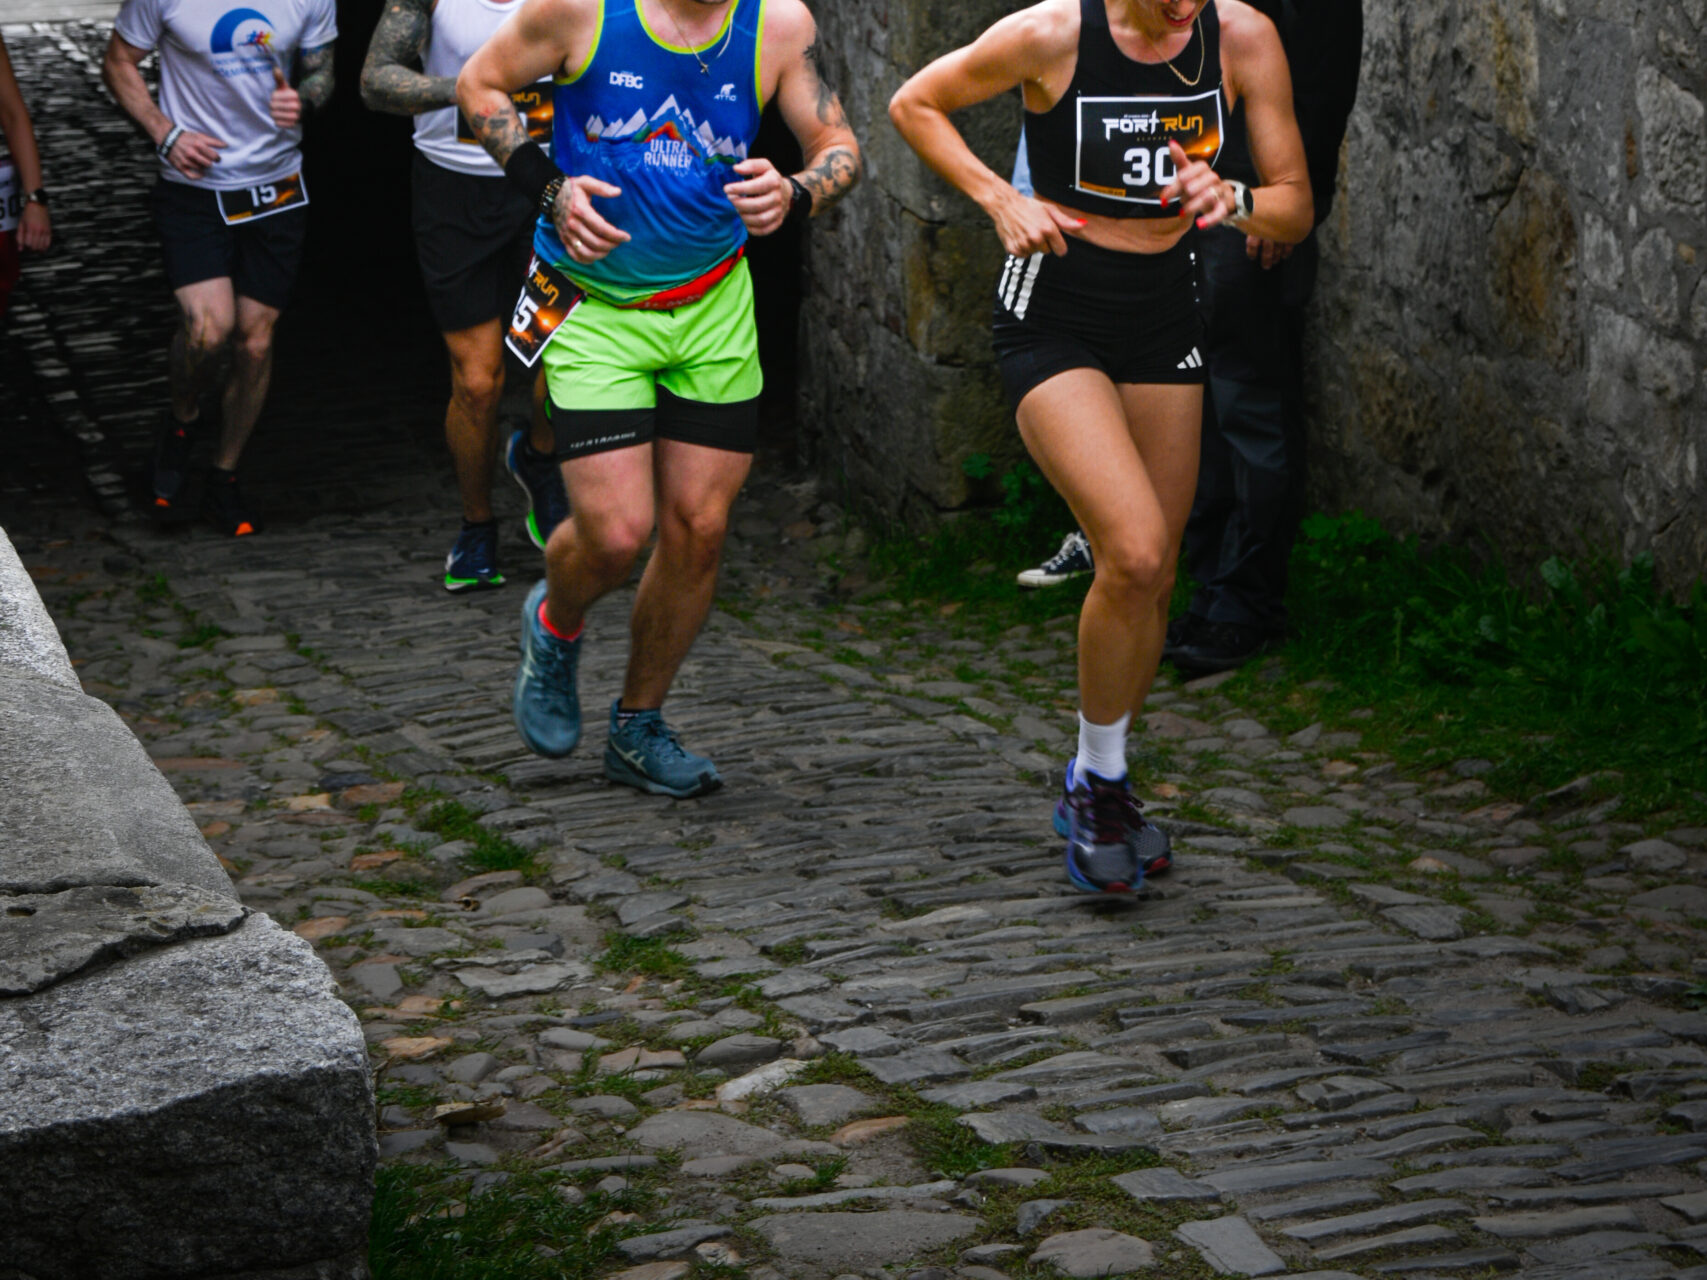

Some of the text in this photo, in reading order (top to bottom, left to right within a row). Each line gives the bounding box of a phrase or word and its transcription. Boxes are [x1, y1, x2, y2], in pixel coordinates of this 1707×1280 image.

[650, 138, 688, 154] ULTRA
[643, 151, 693, 169] RUNNER
[1123, 146, 1177, 186] 30
[247, 184, 278, 208] 15
[511, 286, 540, 333] 5
